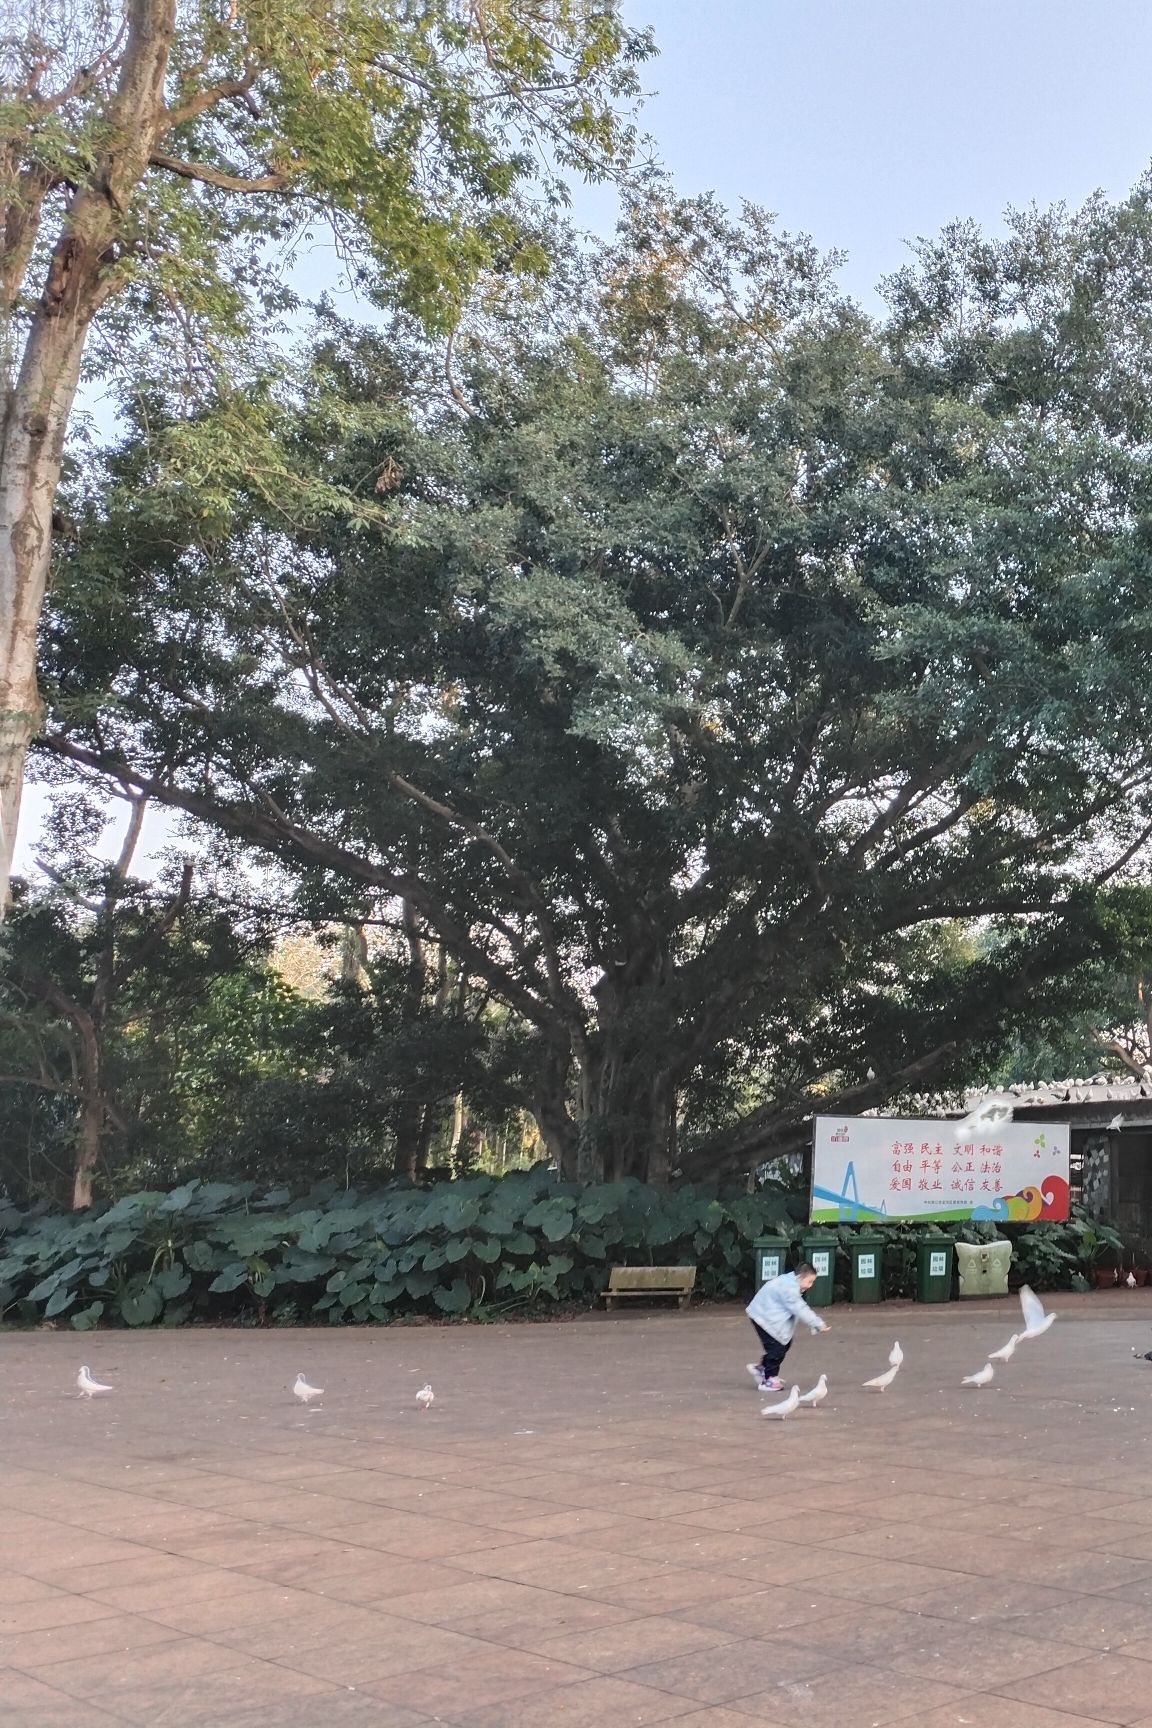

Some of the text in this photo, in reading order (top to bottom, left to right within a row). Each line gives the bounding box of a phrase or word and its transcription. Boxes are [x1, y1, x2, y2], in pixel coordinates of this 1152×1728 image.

[891, 1140, 1003, 1156] 富强 民主 文明 和谐
[892, 1160, 1002, 1174] 自由 平等 公正 法治
[889, 1177, 1003, 1192] 爱国 敬业 诚信 友善
